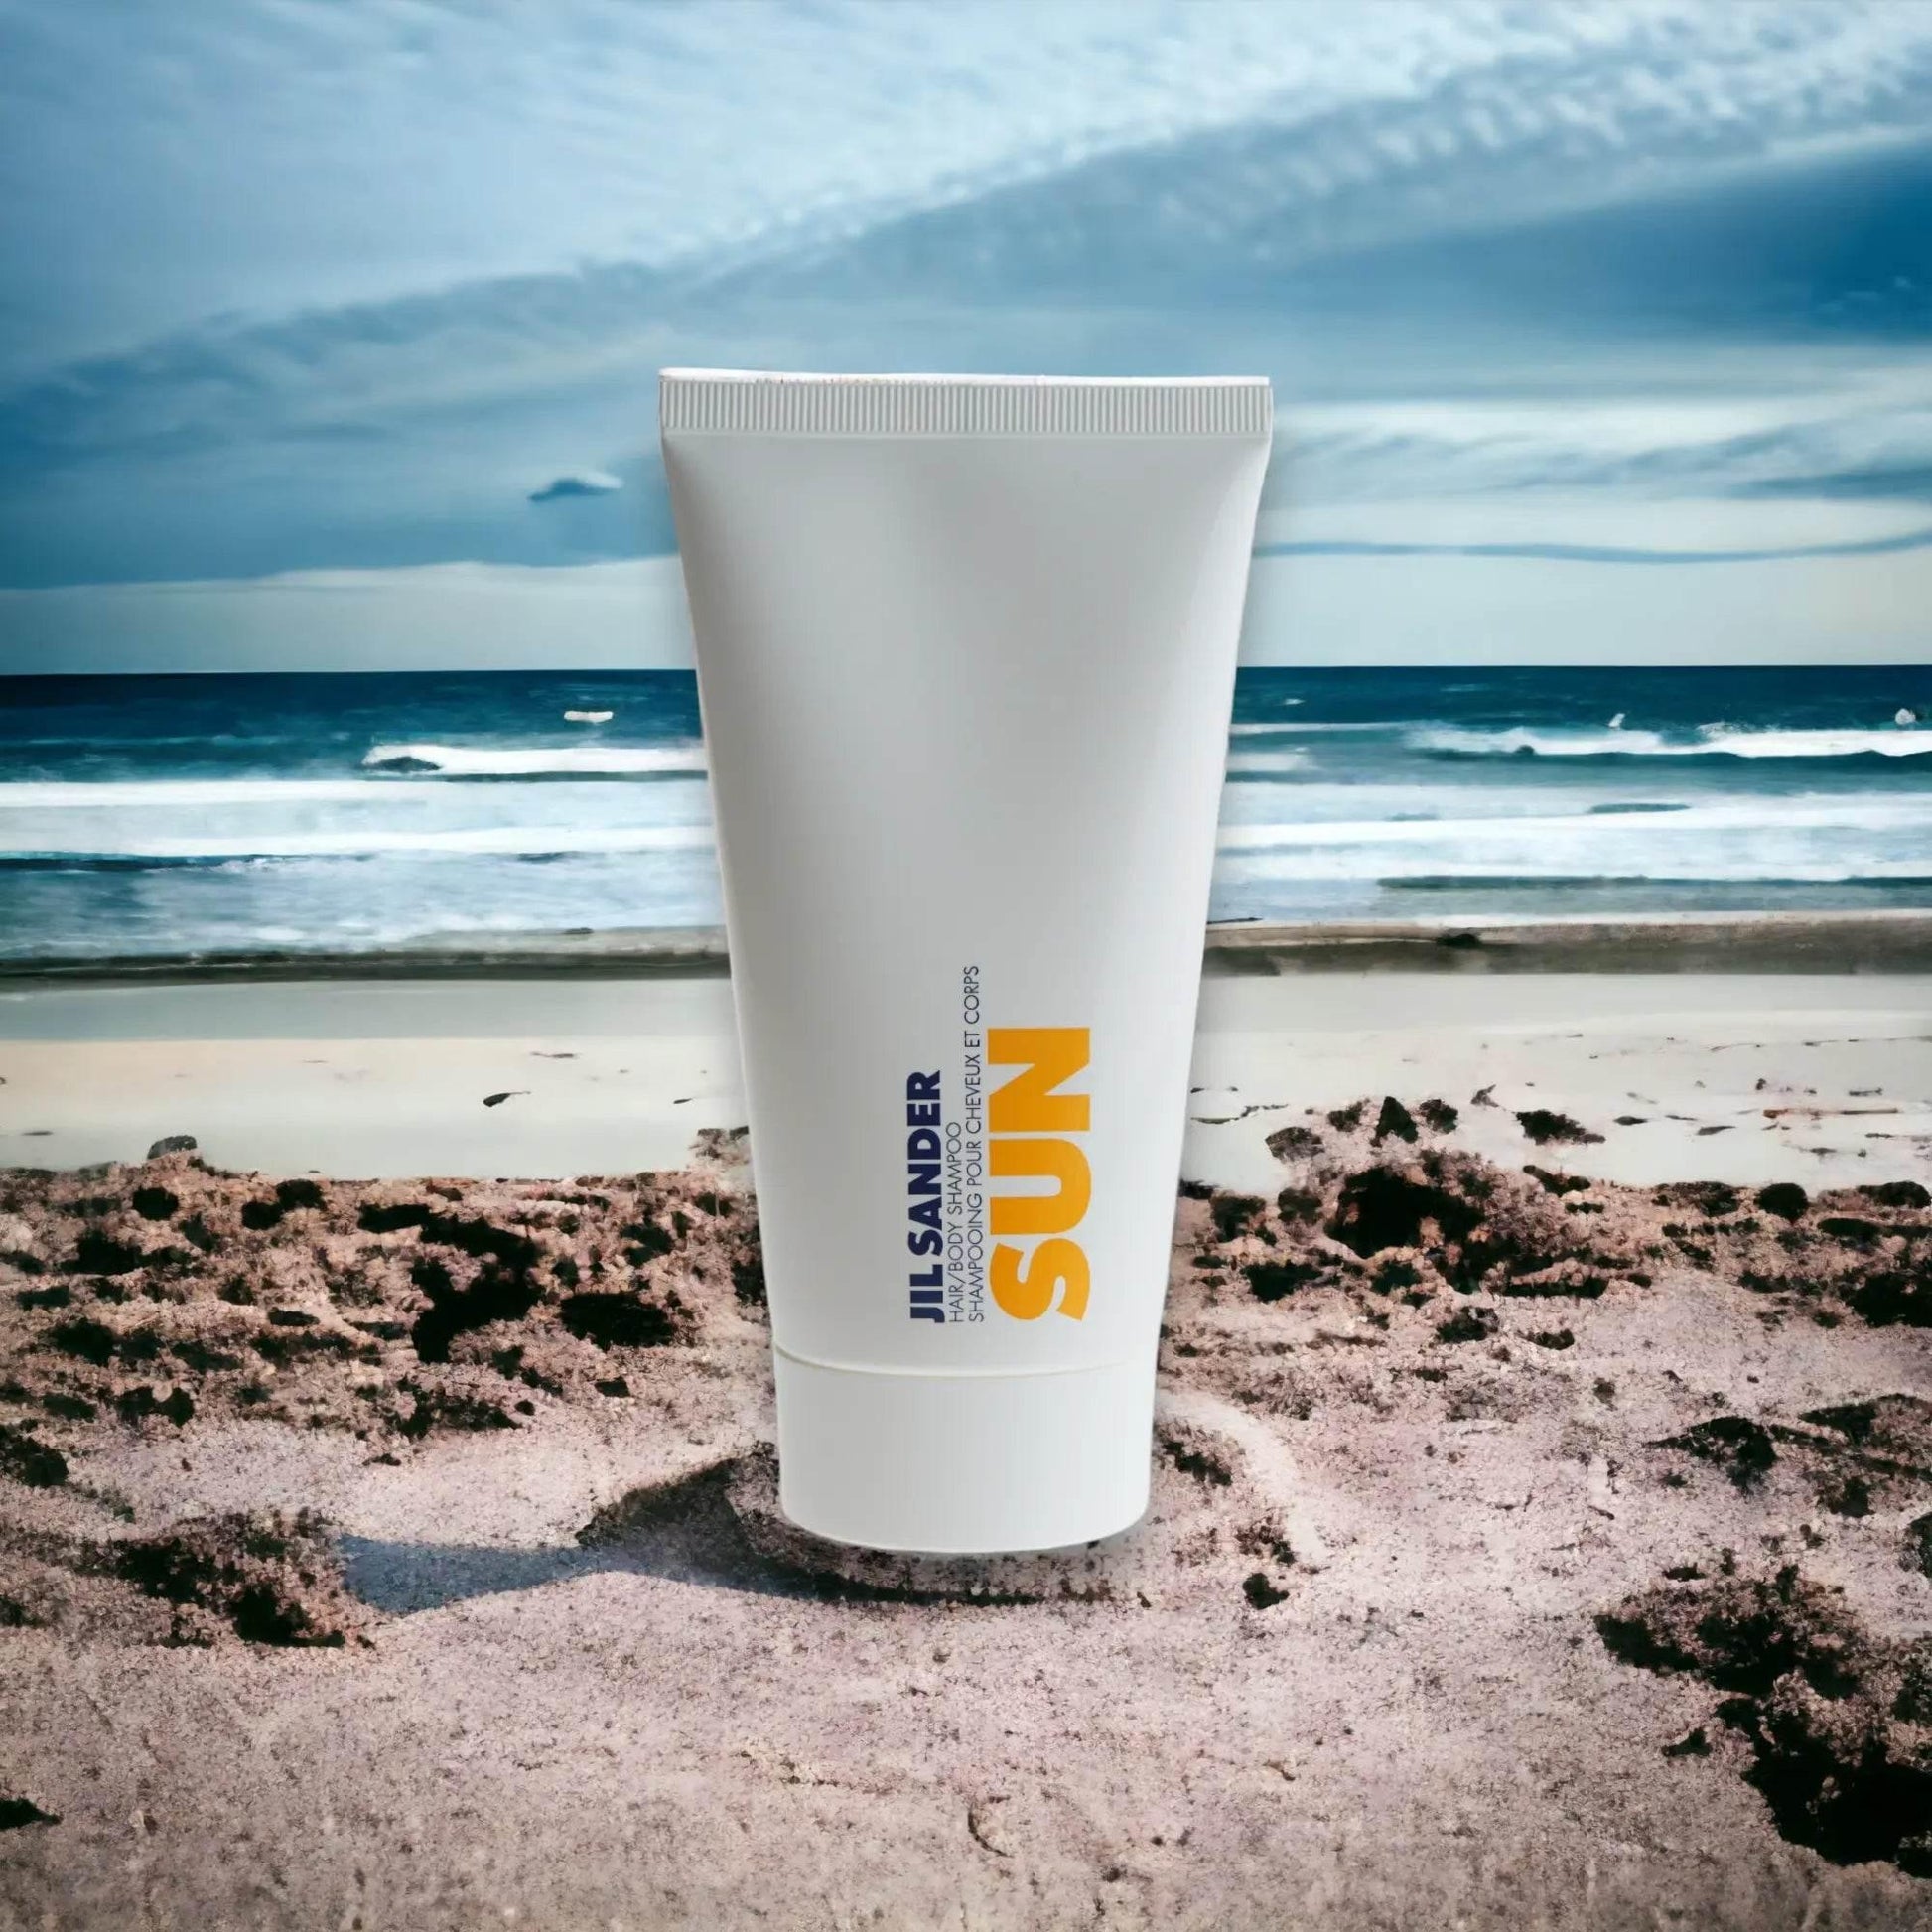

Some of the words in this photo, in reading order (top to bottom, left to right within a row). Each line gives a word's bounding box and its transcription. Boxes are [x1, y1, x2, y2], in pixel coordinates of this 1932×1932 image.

[963, 965, 980, 1025] CORPS
[964, 1031, 981, 1048] ET
[964, 1054, 982, 1134] CHEVEUX
[906, 1070, 943, 1257] SANDER
[945, 1122, 963, 1215] SHAMPOO
[965, 1140, 983, 1186] POUR
[987, 1027, 1092, 1322] SUN
[909, 1264, 945, 1323] JIL
[947, 1222, 965, 1323] HAIR/BODY
[966, 1193, 984, 1323] SHAMPOOING
